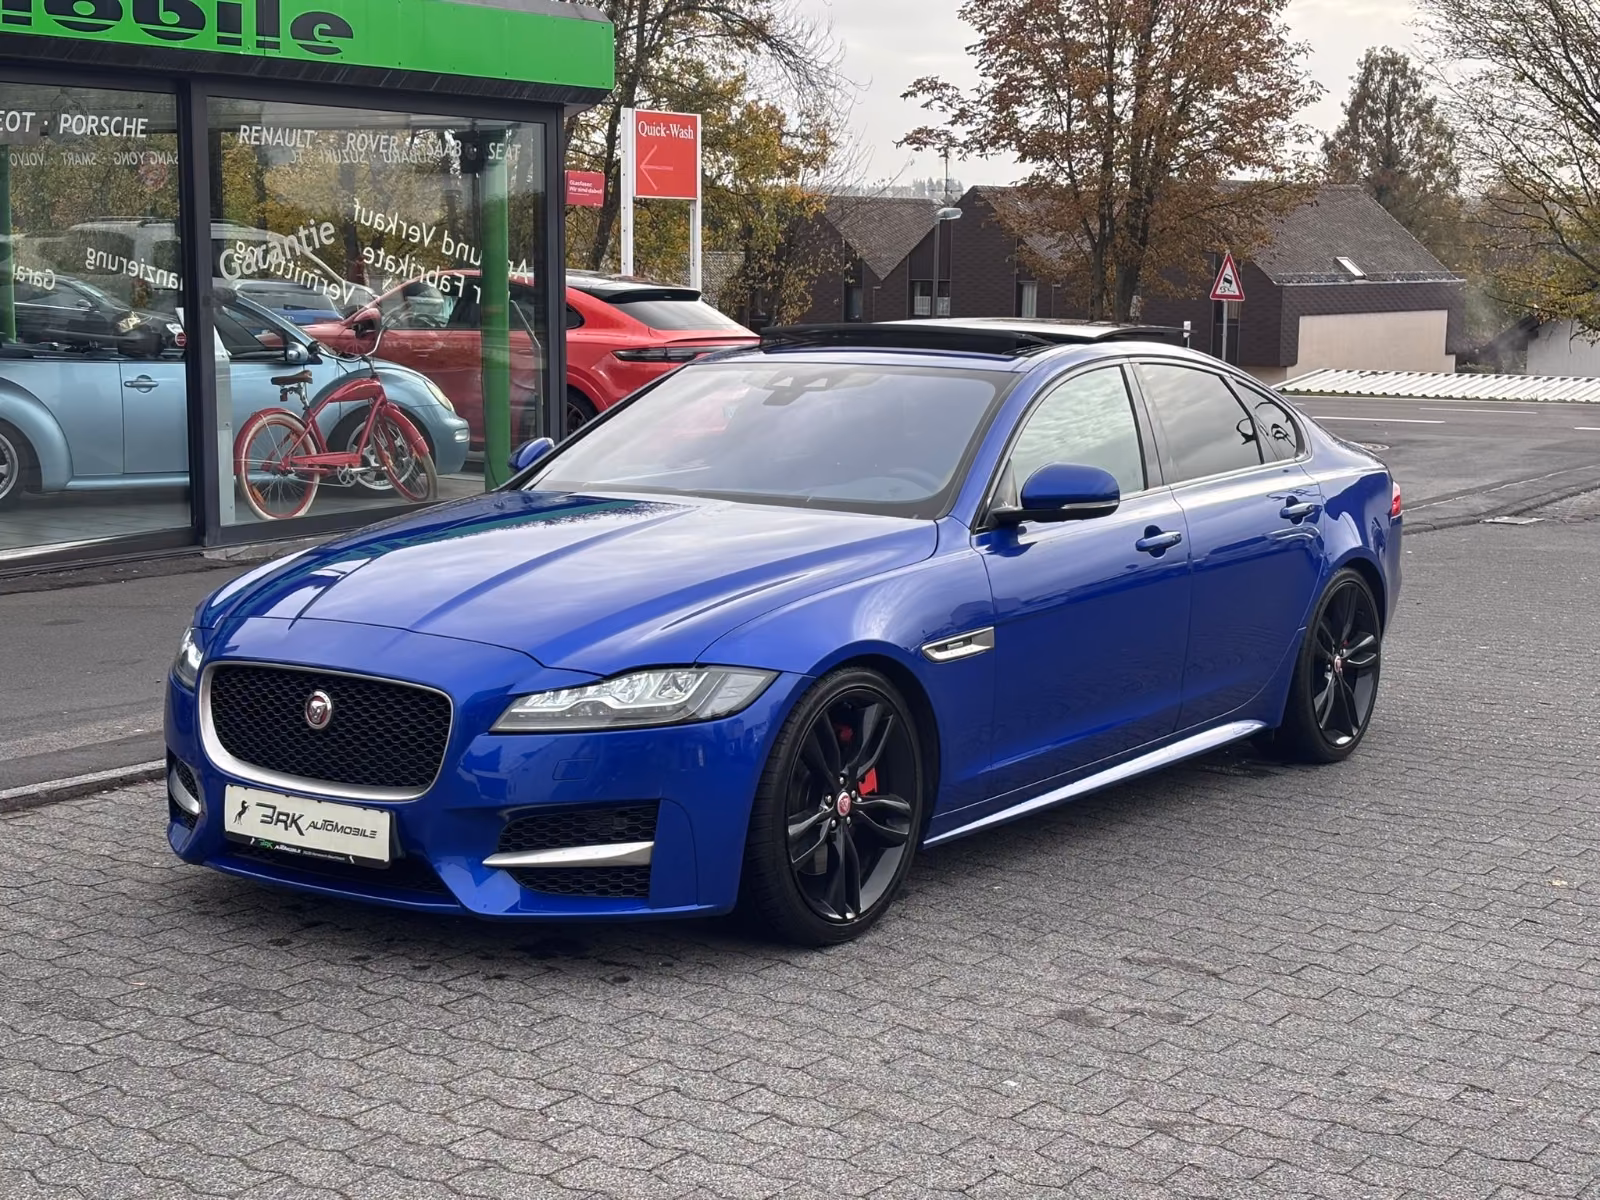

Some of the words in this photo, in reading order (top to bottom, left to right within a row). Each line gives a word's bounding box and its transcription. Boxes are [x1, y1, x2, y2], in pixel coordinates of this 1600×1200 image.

[1, 0, 355, 56] obile
[59, 113, 149, 138] PORSCHE
[239, 124, 315, 149] RENAULT
[345, 133, 398, 153] ROVER
[488, 142, 521, 160] SEAT
[638, 120, 694, 140] Quick-Wash
[219, 218, 336, 281] Garantie
